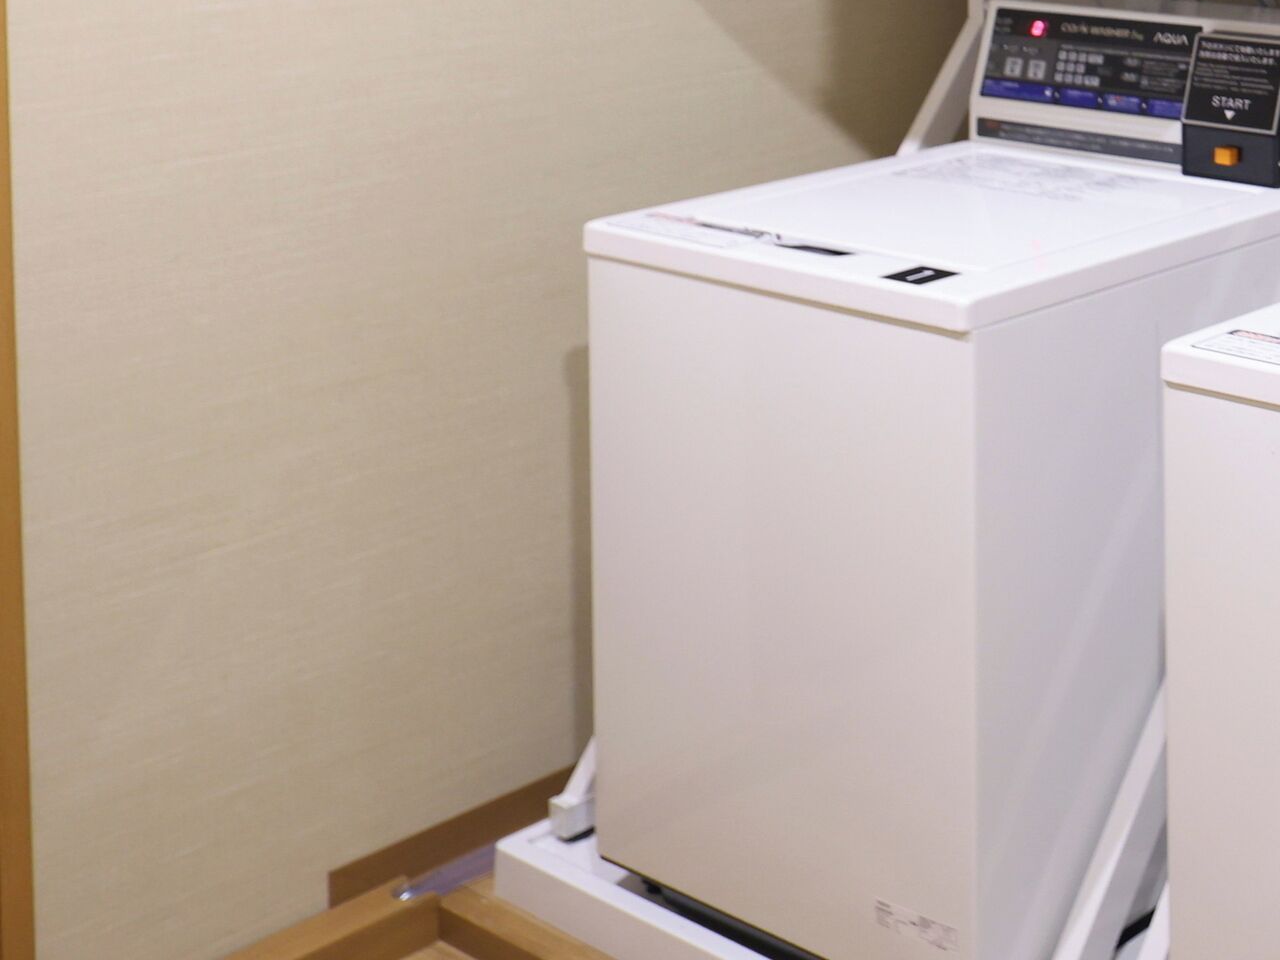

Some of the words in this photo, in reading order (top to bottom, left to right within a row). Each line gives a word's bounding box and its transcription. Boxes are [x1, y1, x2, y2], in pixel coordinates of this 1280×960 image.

[1153, 32, 1189, 45] AQUA
[1211, 95, 1251, 110] START
[906, 269, 935, 282] 1
